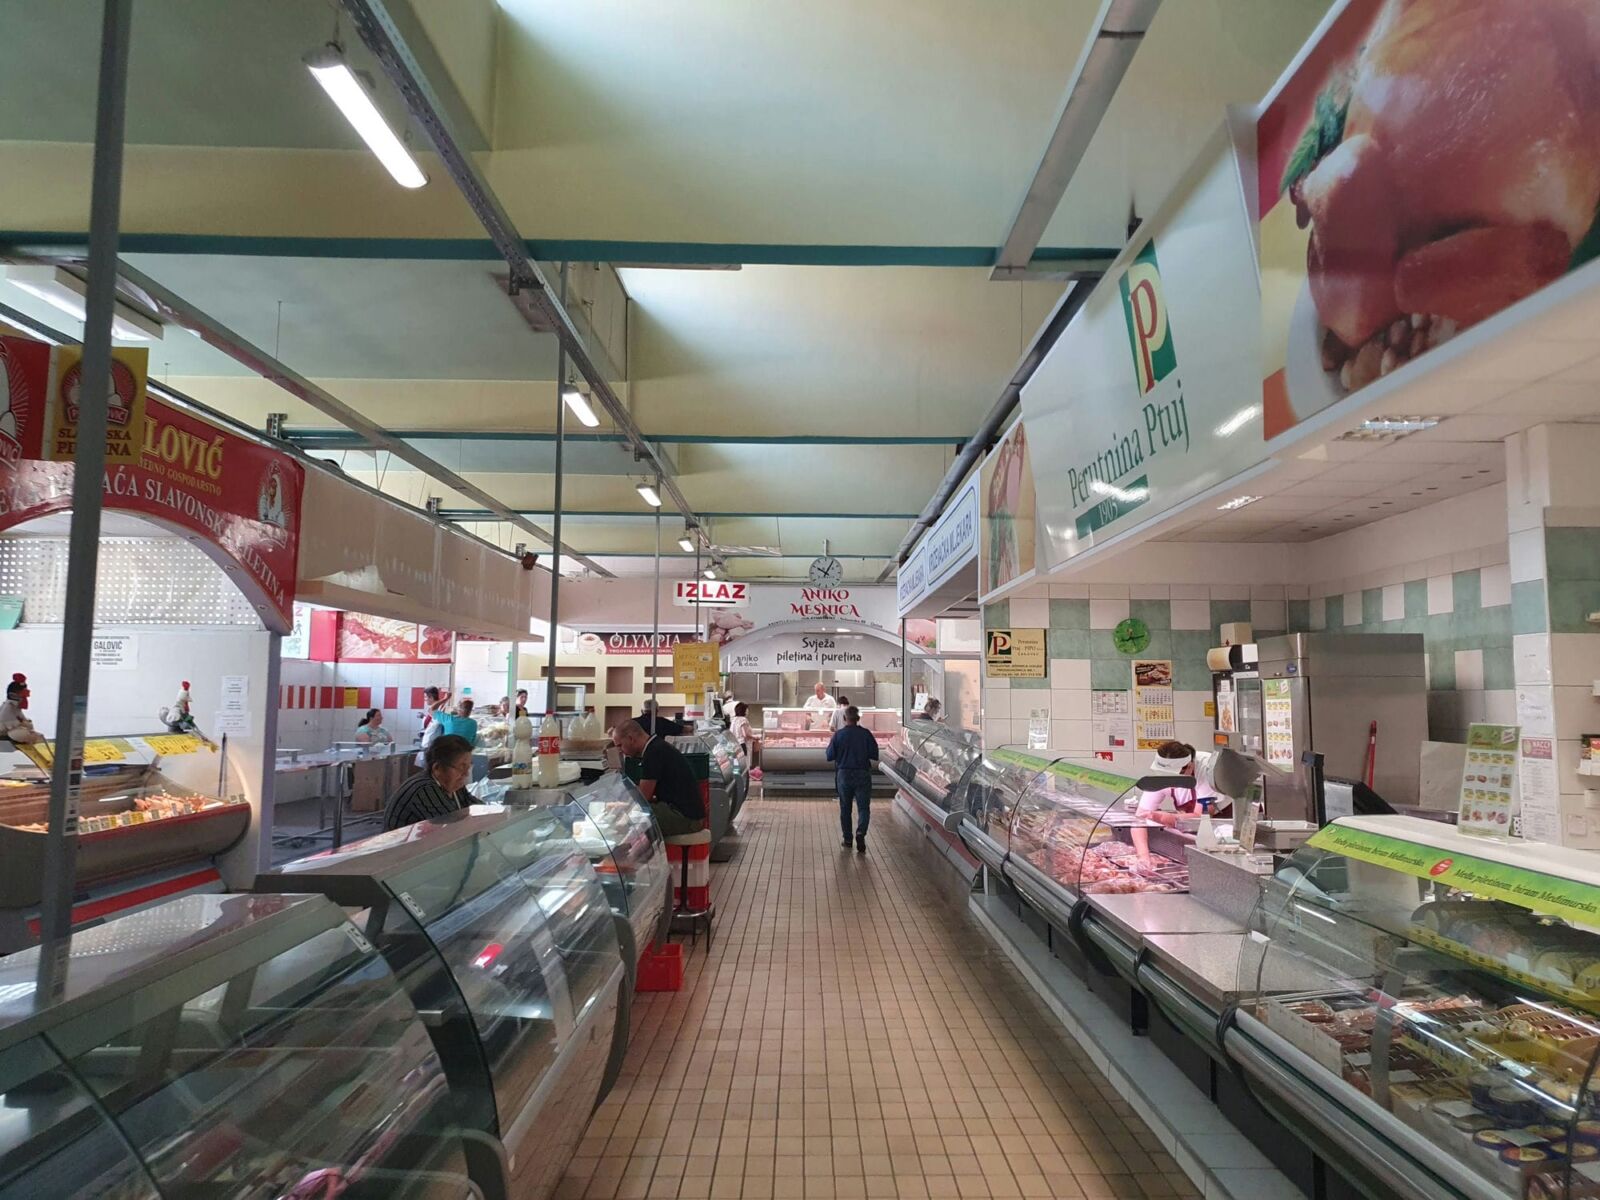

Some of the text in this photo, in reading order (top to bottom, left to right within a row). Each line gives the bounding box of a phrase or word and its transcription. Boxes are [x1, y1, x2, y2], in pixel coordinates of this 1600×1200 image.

[143, 414, 225, 480] LOVIĆ
[1067, 376, 1190, 510] Perutnina Ptuj
[102, 464, 140, 498] AĆA
[144, 478, 229, 540] SLAVONSK
[241, 543, 285, 608] ILETINA
[677, 582, 746, 599] IZLAZ
[790, 602, 861, 618] MESNICA
[93, 640, 123, 650] GALOVIĆ
[609, 633, 681, 649] OLYMPIA
[802, 637, 835, 652] Svježa
[776, 651, 813, 664] piletina
[820, 652, 862, 665] puretina
